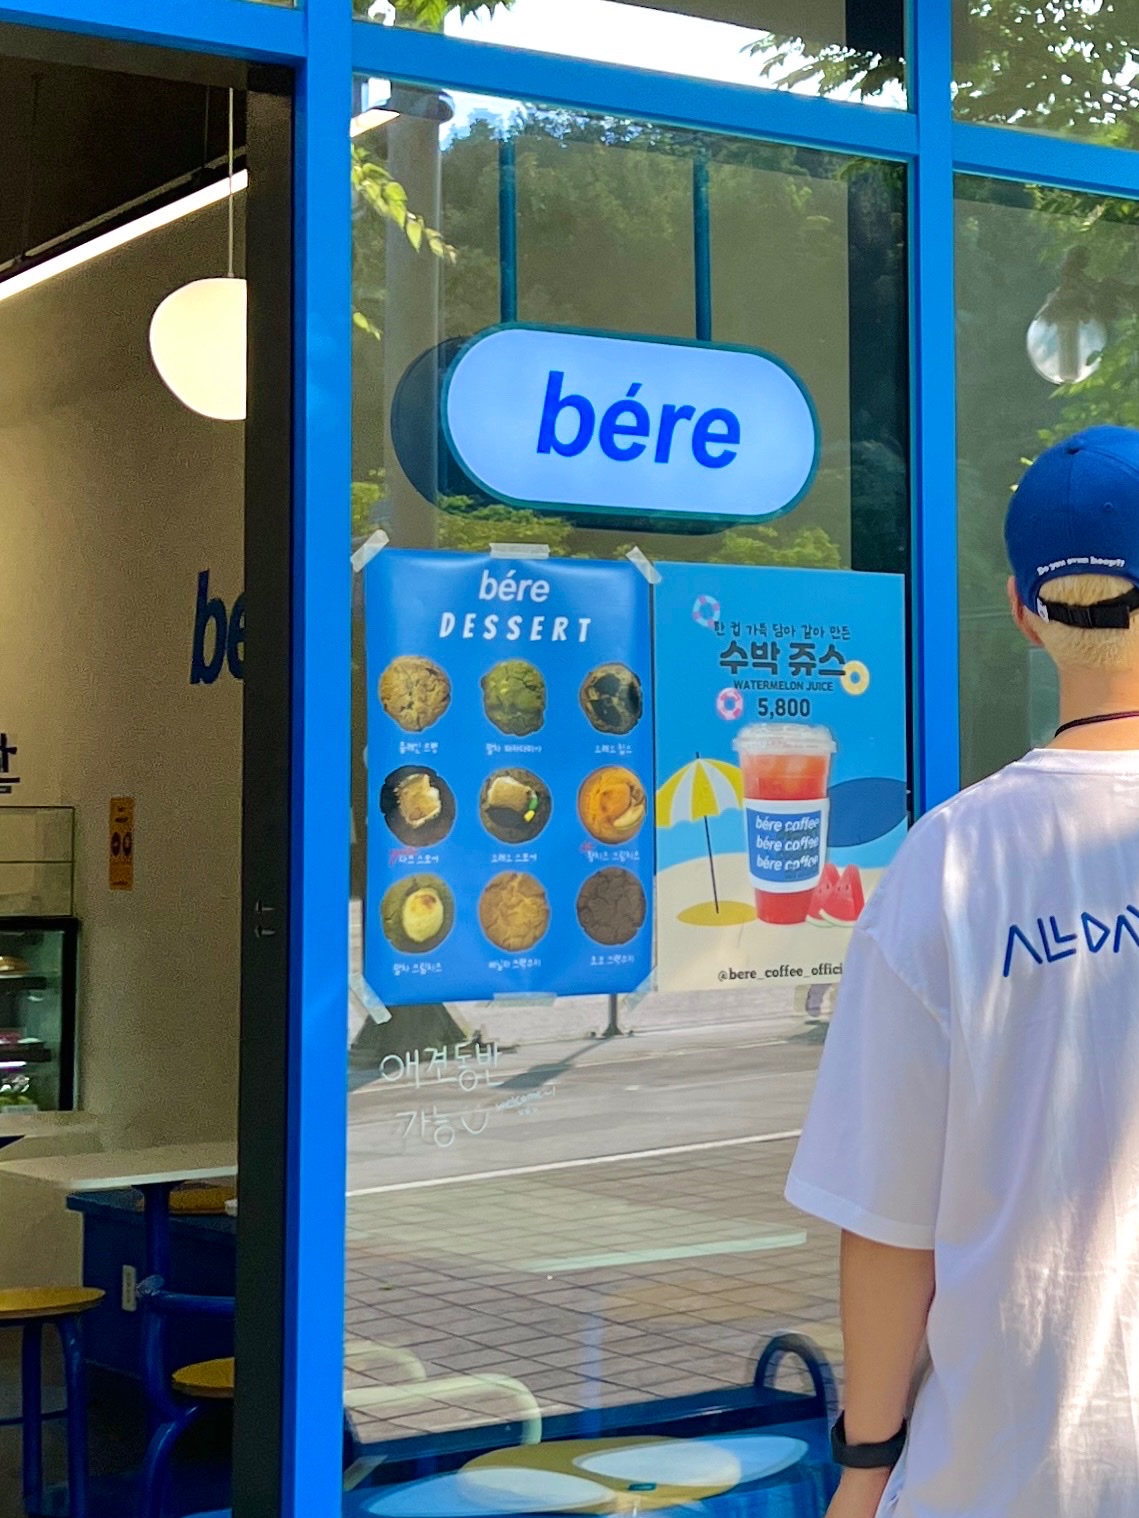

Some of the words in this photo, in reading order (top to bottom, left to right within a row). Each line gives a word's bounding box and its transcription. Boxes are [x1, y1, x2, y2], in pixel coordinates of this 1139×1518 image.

[536, 370, 741, 469] bére
[478, 569, 550, 602] bére
[439, 612, 591, 642] DESSERT
[747, 622, 768, 637] 가득
[772, 623, 796, 638] 담아
[829, 625, 851, 640] 만든
[720, 640, 780, 675] 수박
[788, 642, 846, 676] 쥬스
[734, 680, 804, 691] WATERMELON
[805, 681, 834, 692] JUICE
[758, 698, 811, 719] 5,800
[756, 815, 783, 832] bére
[756, 834, 783, 852] bére
[757, 854, 783, 871] bére
[380, 1041, 504, 1092] 애견동반
[395, 1105, 455, 1147] 가능
